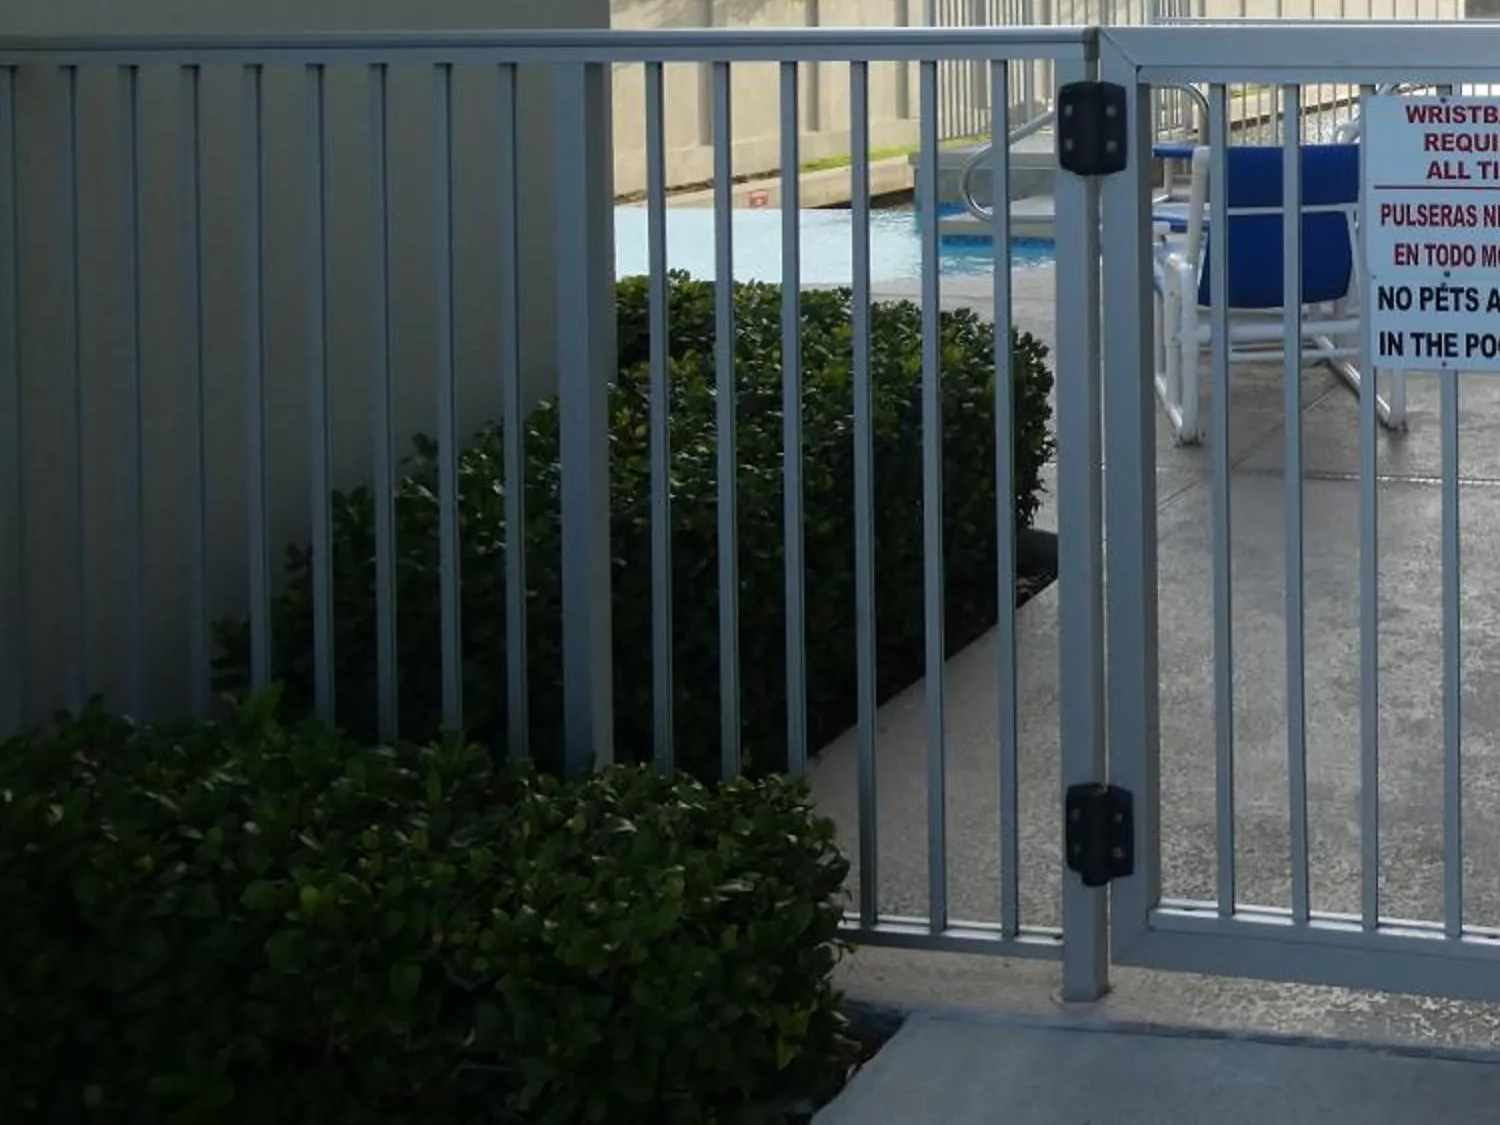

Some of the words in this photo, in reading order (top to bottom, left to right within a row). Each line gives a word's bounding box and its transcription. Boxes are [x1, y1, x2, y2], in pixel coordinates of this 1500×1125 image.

[1426, 160, 1472, 180] ALL
[1380, 203, 1478, 228] PULSERAS
[1394, 242, 1419, 266] EN
[1423, 243, 1477, 268] TODO
[1378, 286, 1413, 311] NO
[1419, 286, 1480, 312] PETS
[1379, 331, 1404, 357] IN
[1409, 332, 1459, 358] THE
